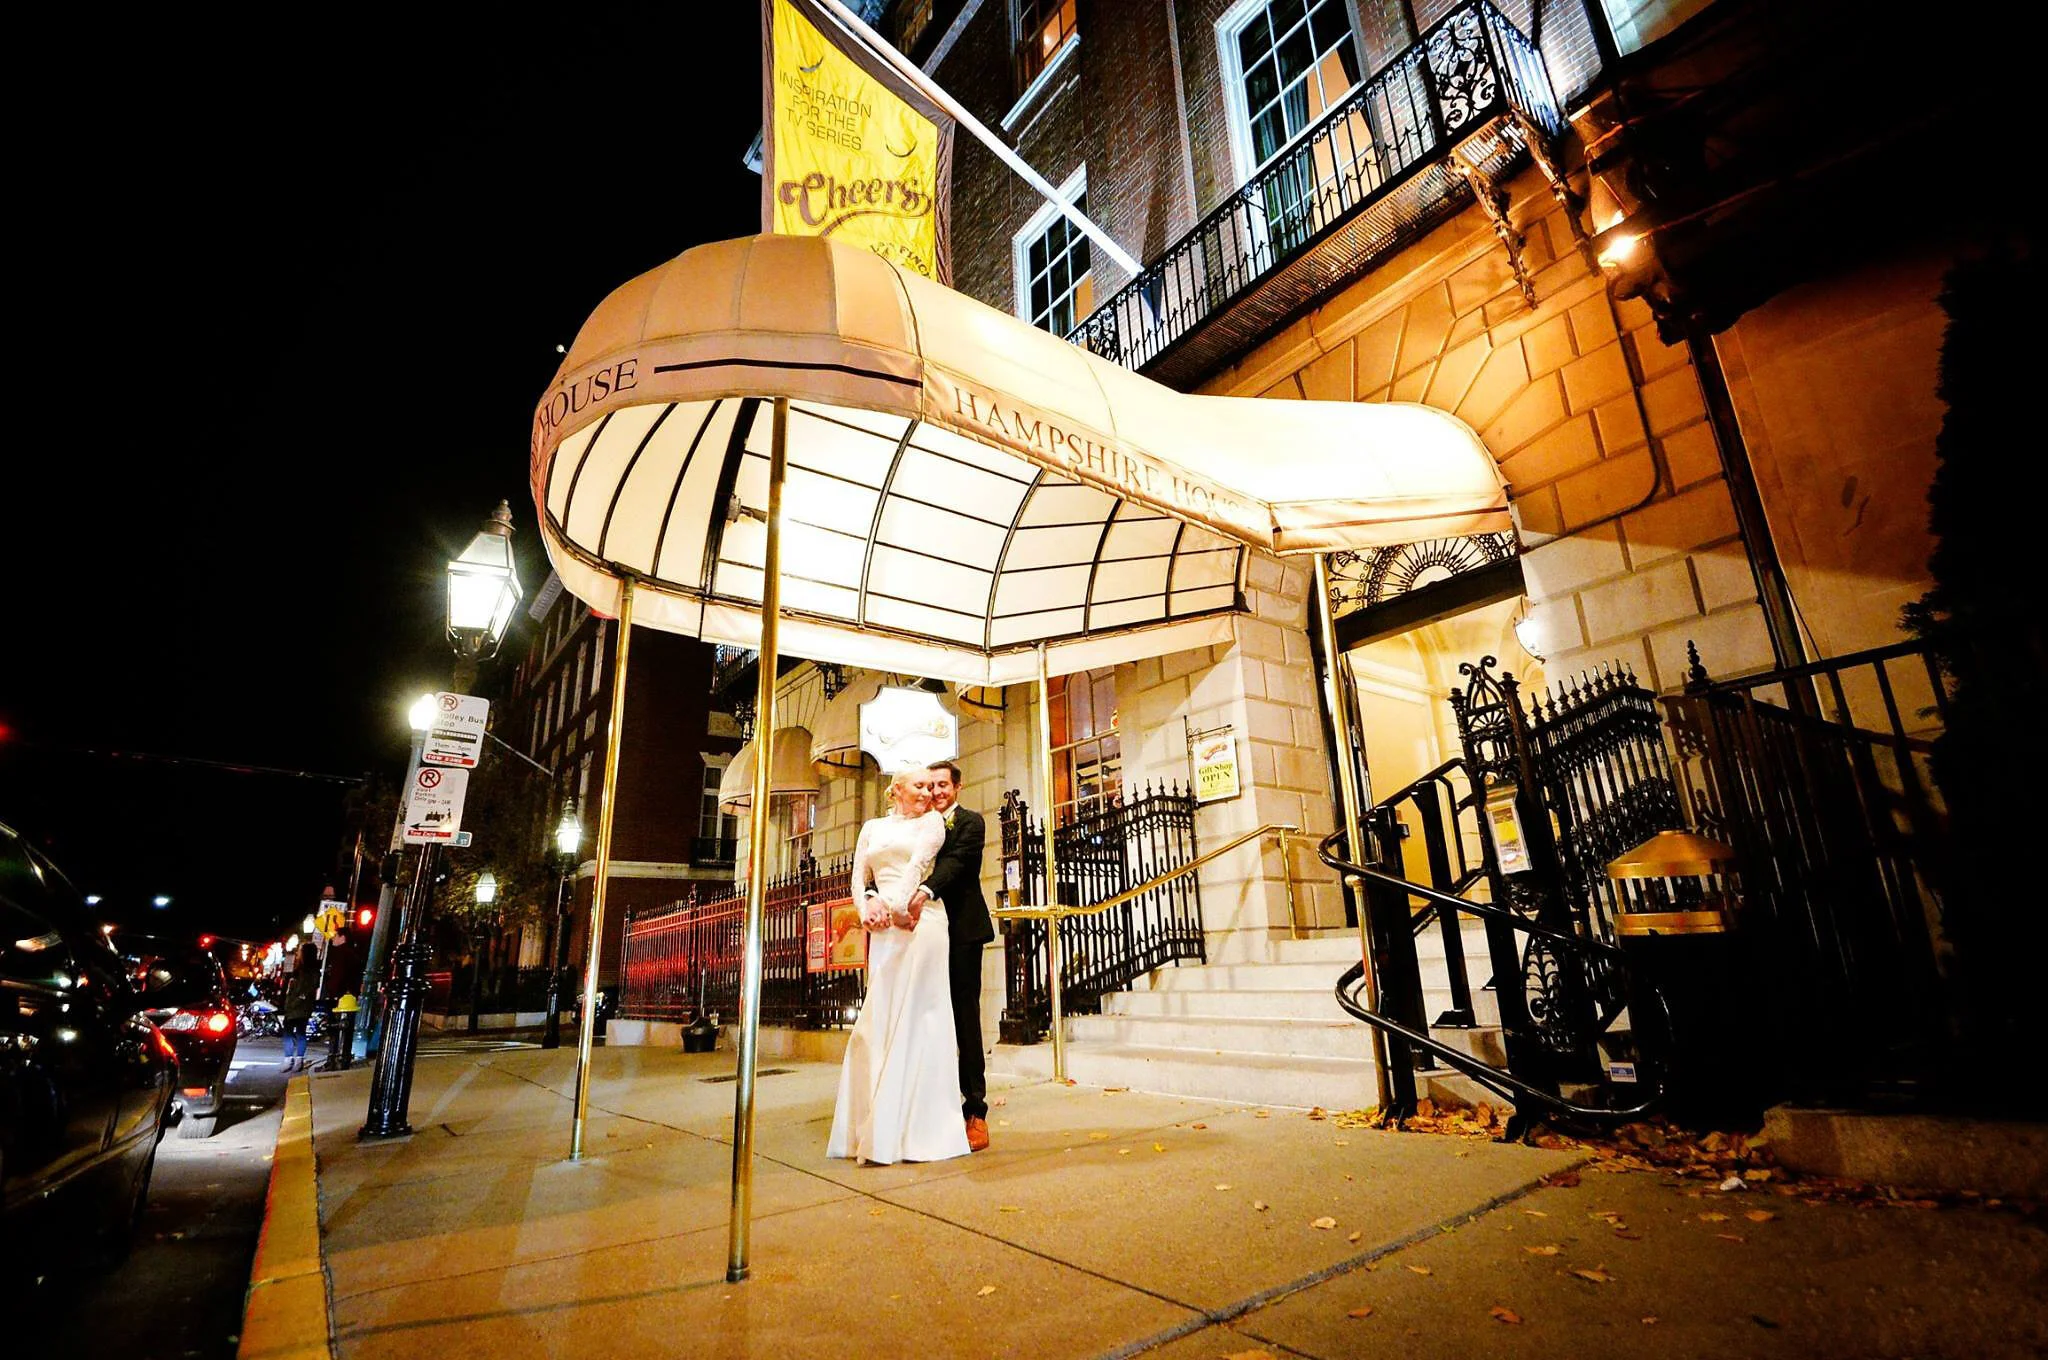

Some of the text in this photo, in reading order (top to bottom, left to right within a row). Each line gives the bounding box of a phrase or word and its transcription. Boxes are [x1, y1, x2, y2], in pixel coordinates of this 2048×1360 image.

[779, 69, 872, 118] INSPIRATION
[792, 95, 857, 132] FOR THE
[785, 107, 862, 151] TV SERIES
[778, 171, 931, 227] Cheers
[539, 358, 638, 437] HOUSE
[954, 386, 1256, 529] HAMPSHIRE HOU
[436, 712, 484, 724] rolley Bus
